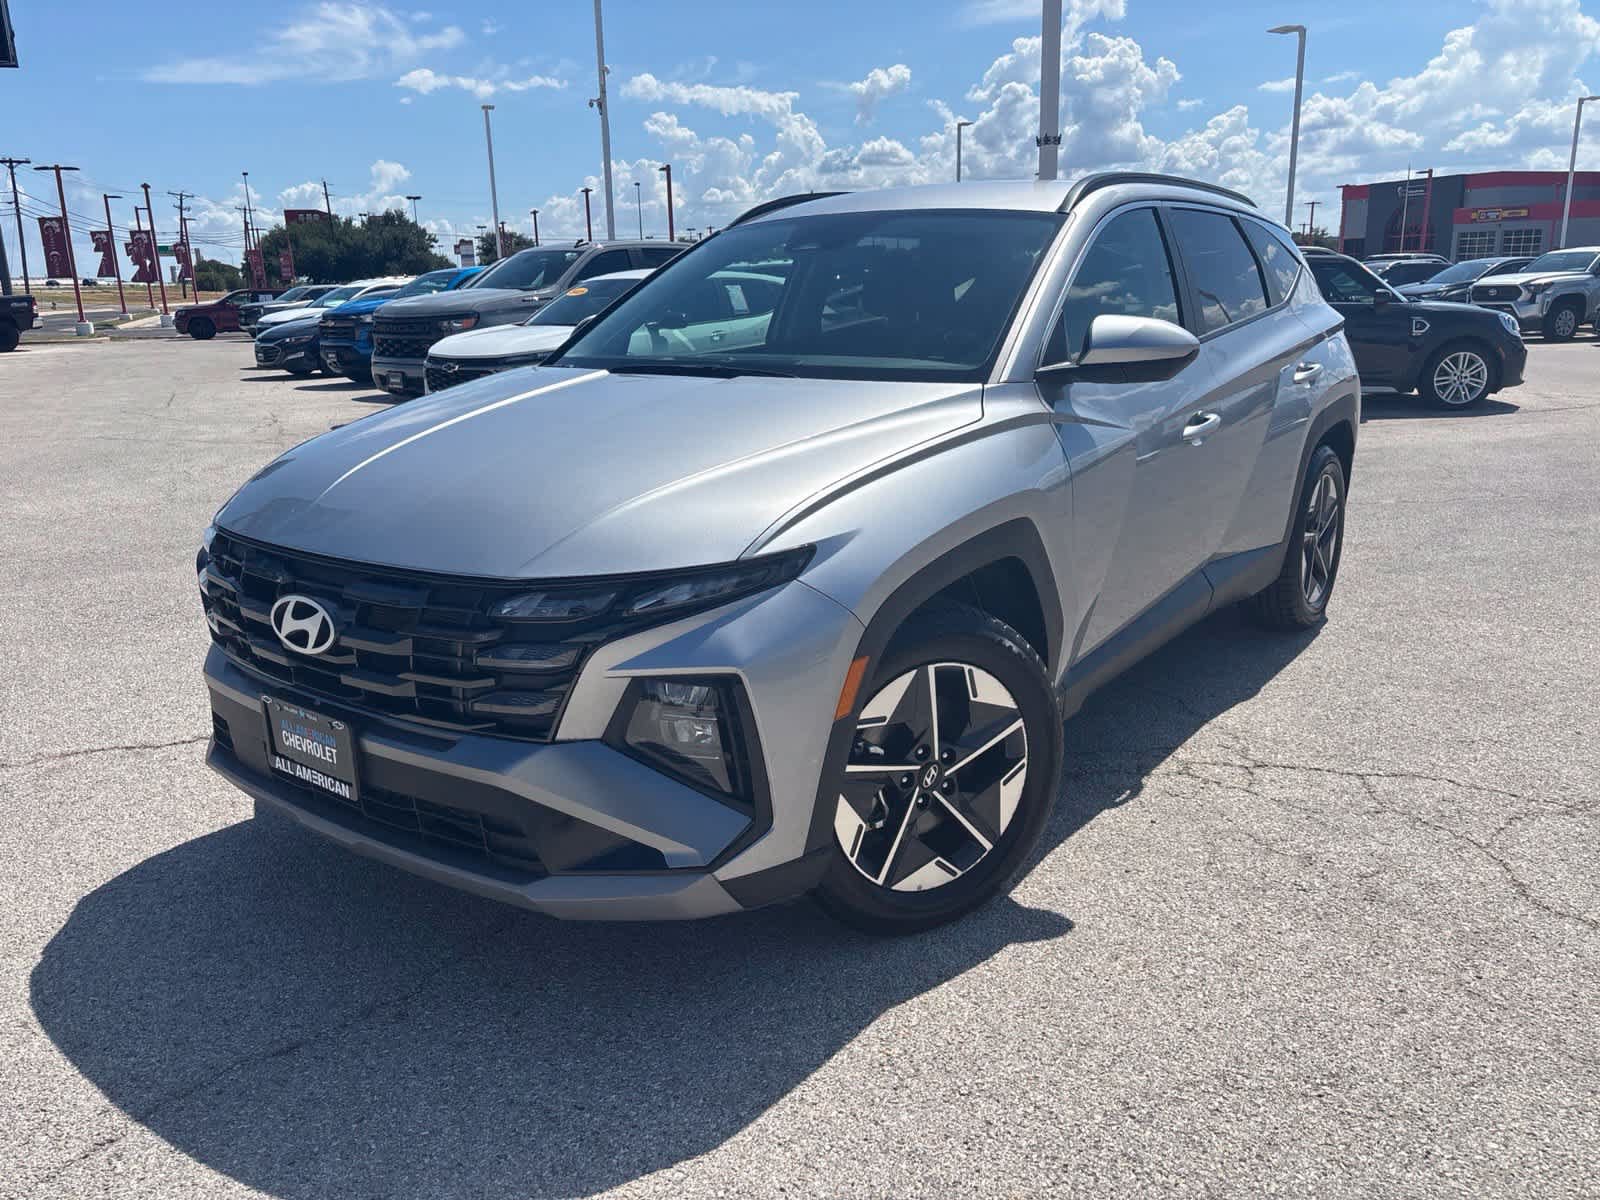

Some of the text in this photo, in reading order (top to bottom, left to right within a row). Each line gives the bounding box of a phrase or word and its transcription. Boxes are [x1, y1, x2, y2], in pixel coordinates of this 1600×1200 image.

[281, 730, 337, 764] CHEVROLET
[275, 757, 350, 799] ALL AMERICAN
